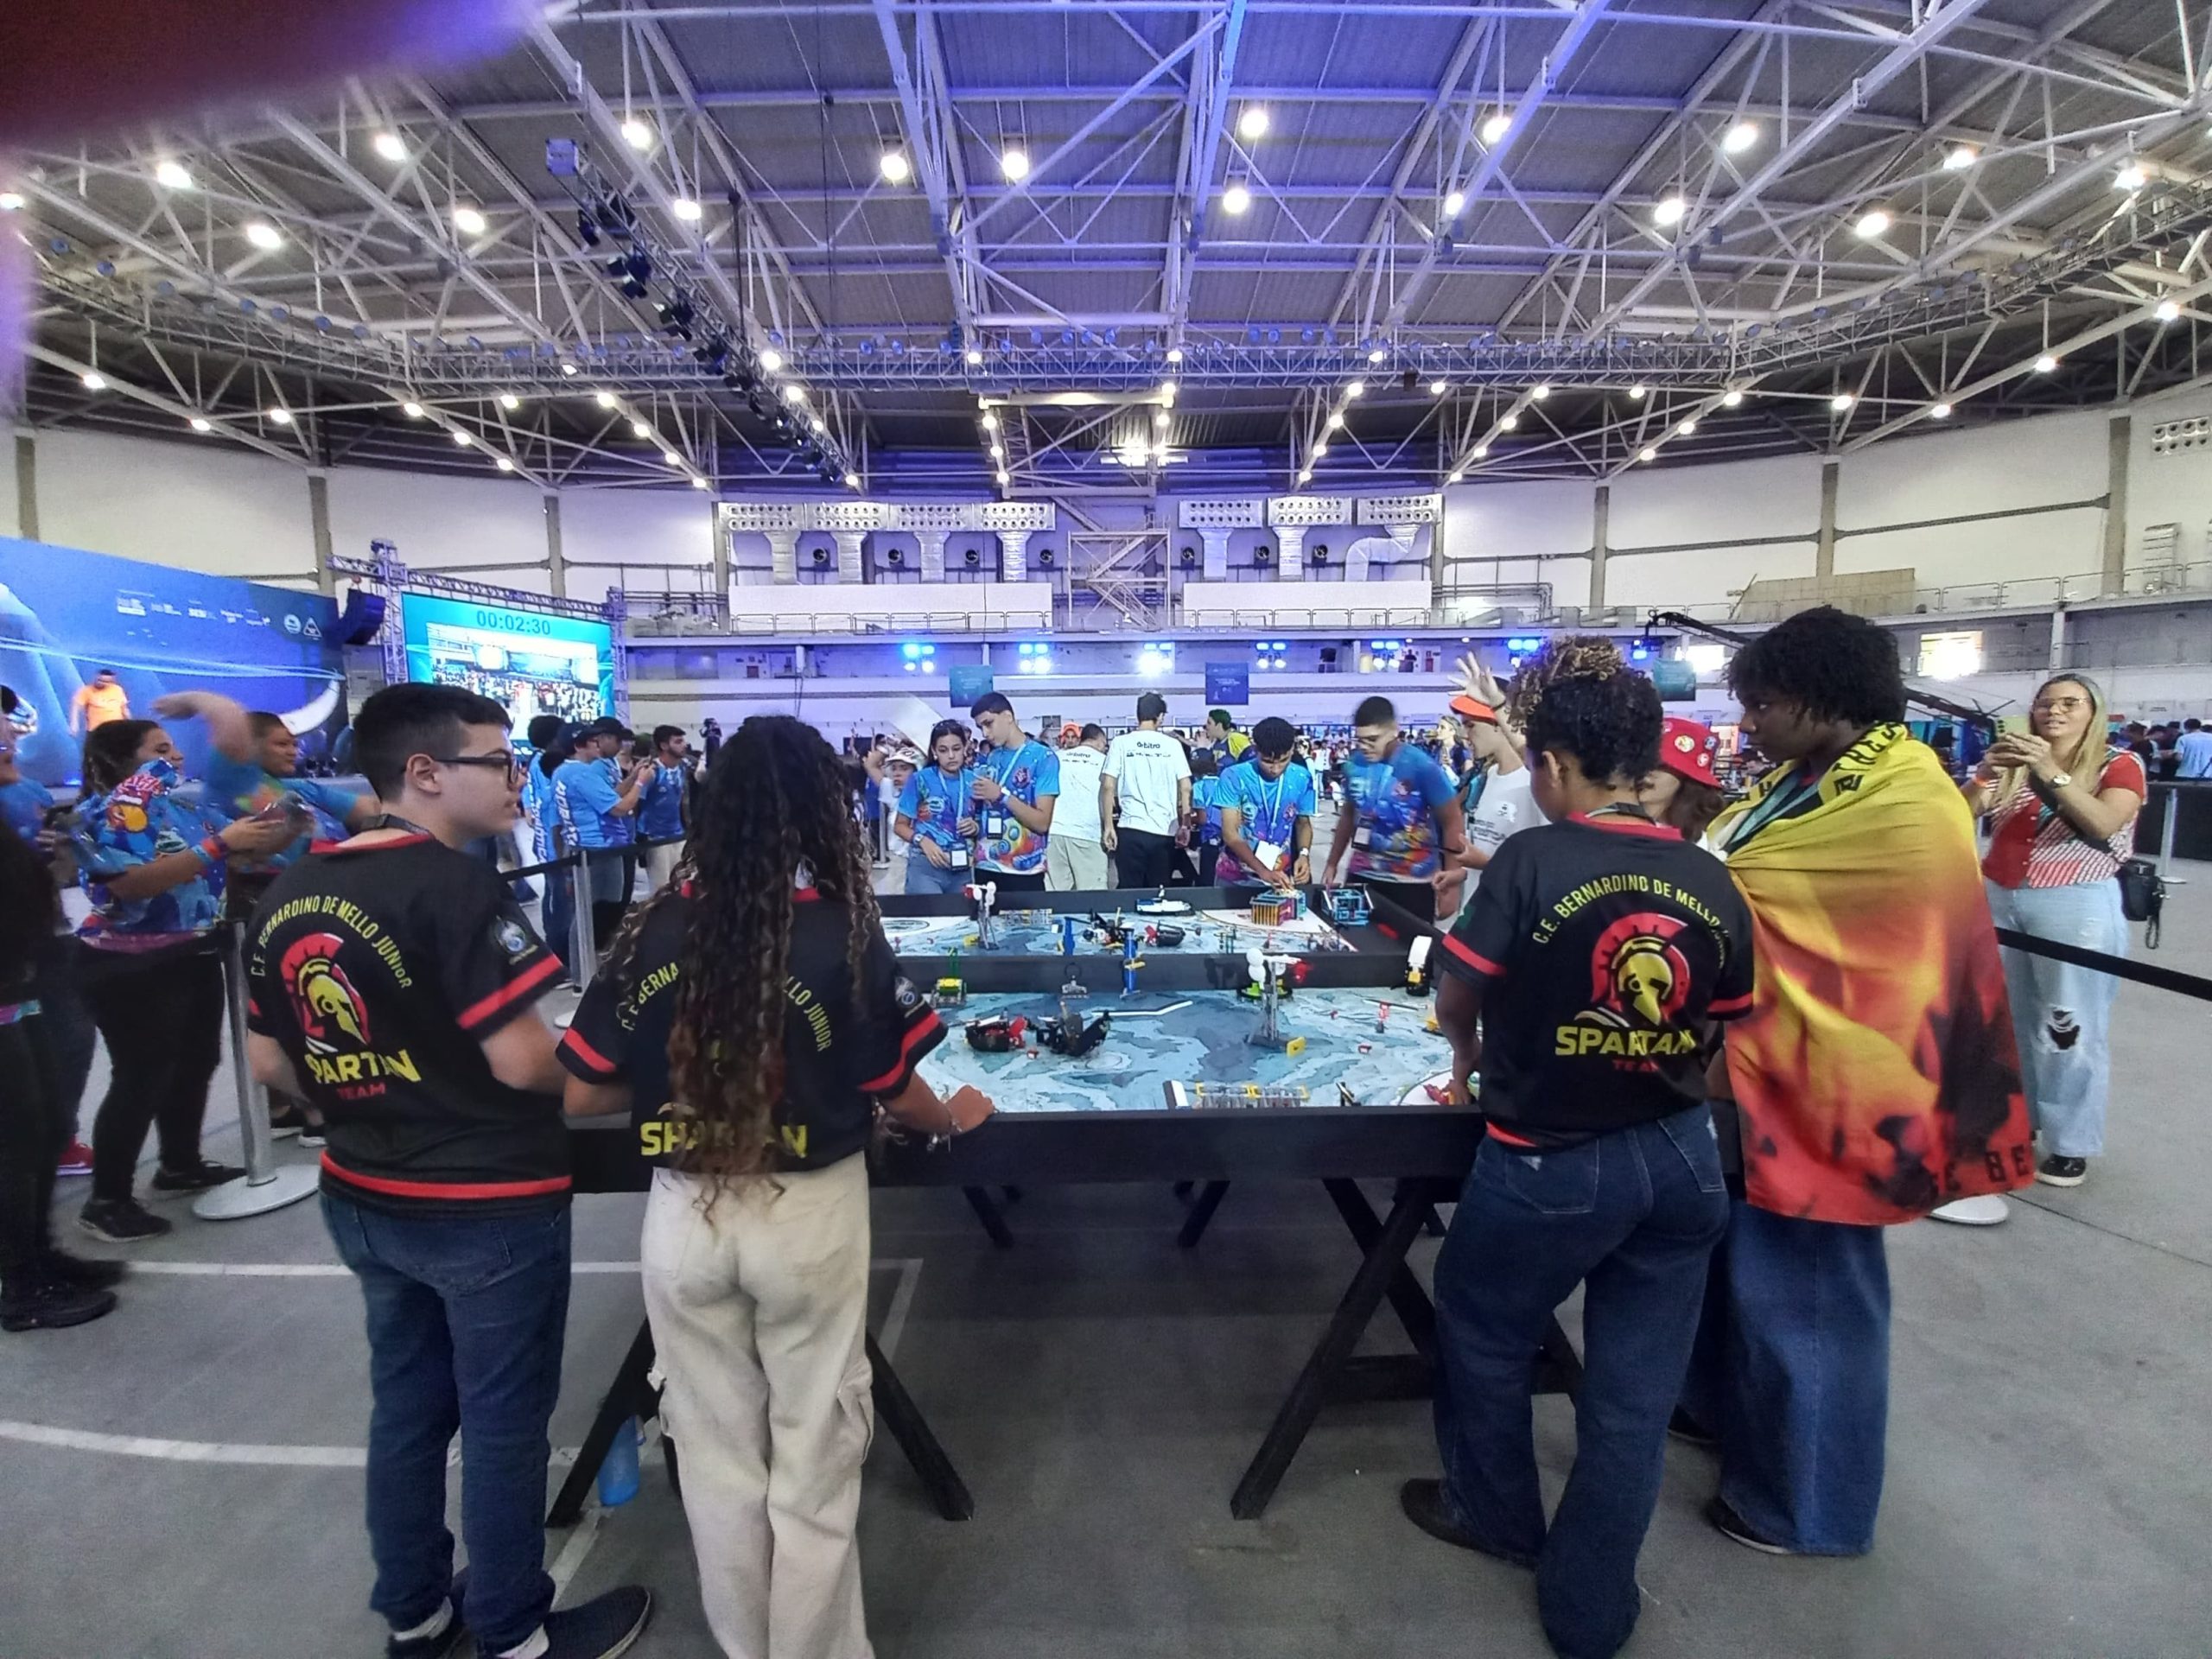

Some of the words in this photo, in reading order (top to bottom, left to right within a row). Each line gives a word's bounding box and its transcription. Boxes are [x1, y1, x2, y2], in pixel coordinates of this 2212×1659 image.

[476, 610, 551, 635] 00:02:30
[1532, 918, 1560, 944] C.E.
[1554, 874, 1649, 919] BERNARDINO
[1653, 878, 1673, 899] DE
[1675, 888, 1721, 927] MELLO
[258, 894, 321, 950] BERNARDINO
[321, 894, 340, 915] DE
[335, 899, 380, 940] MELLO
[371, 935, 413, 989] JUNIOR
[803, 1002, 833, 1052] JUNIOR
[303, 1048, 423, 1084] PARTN
